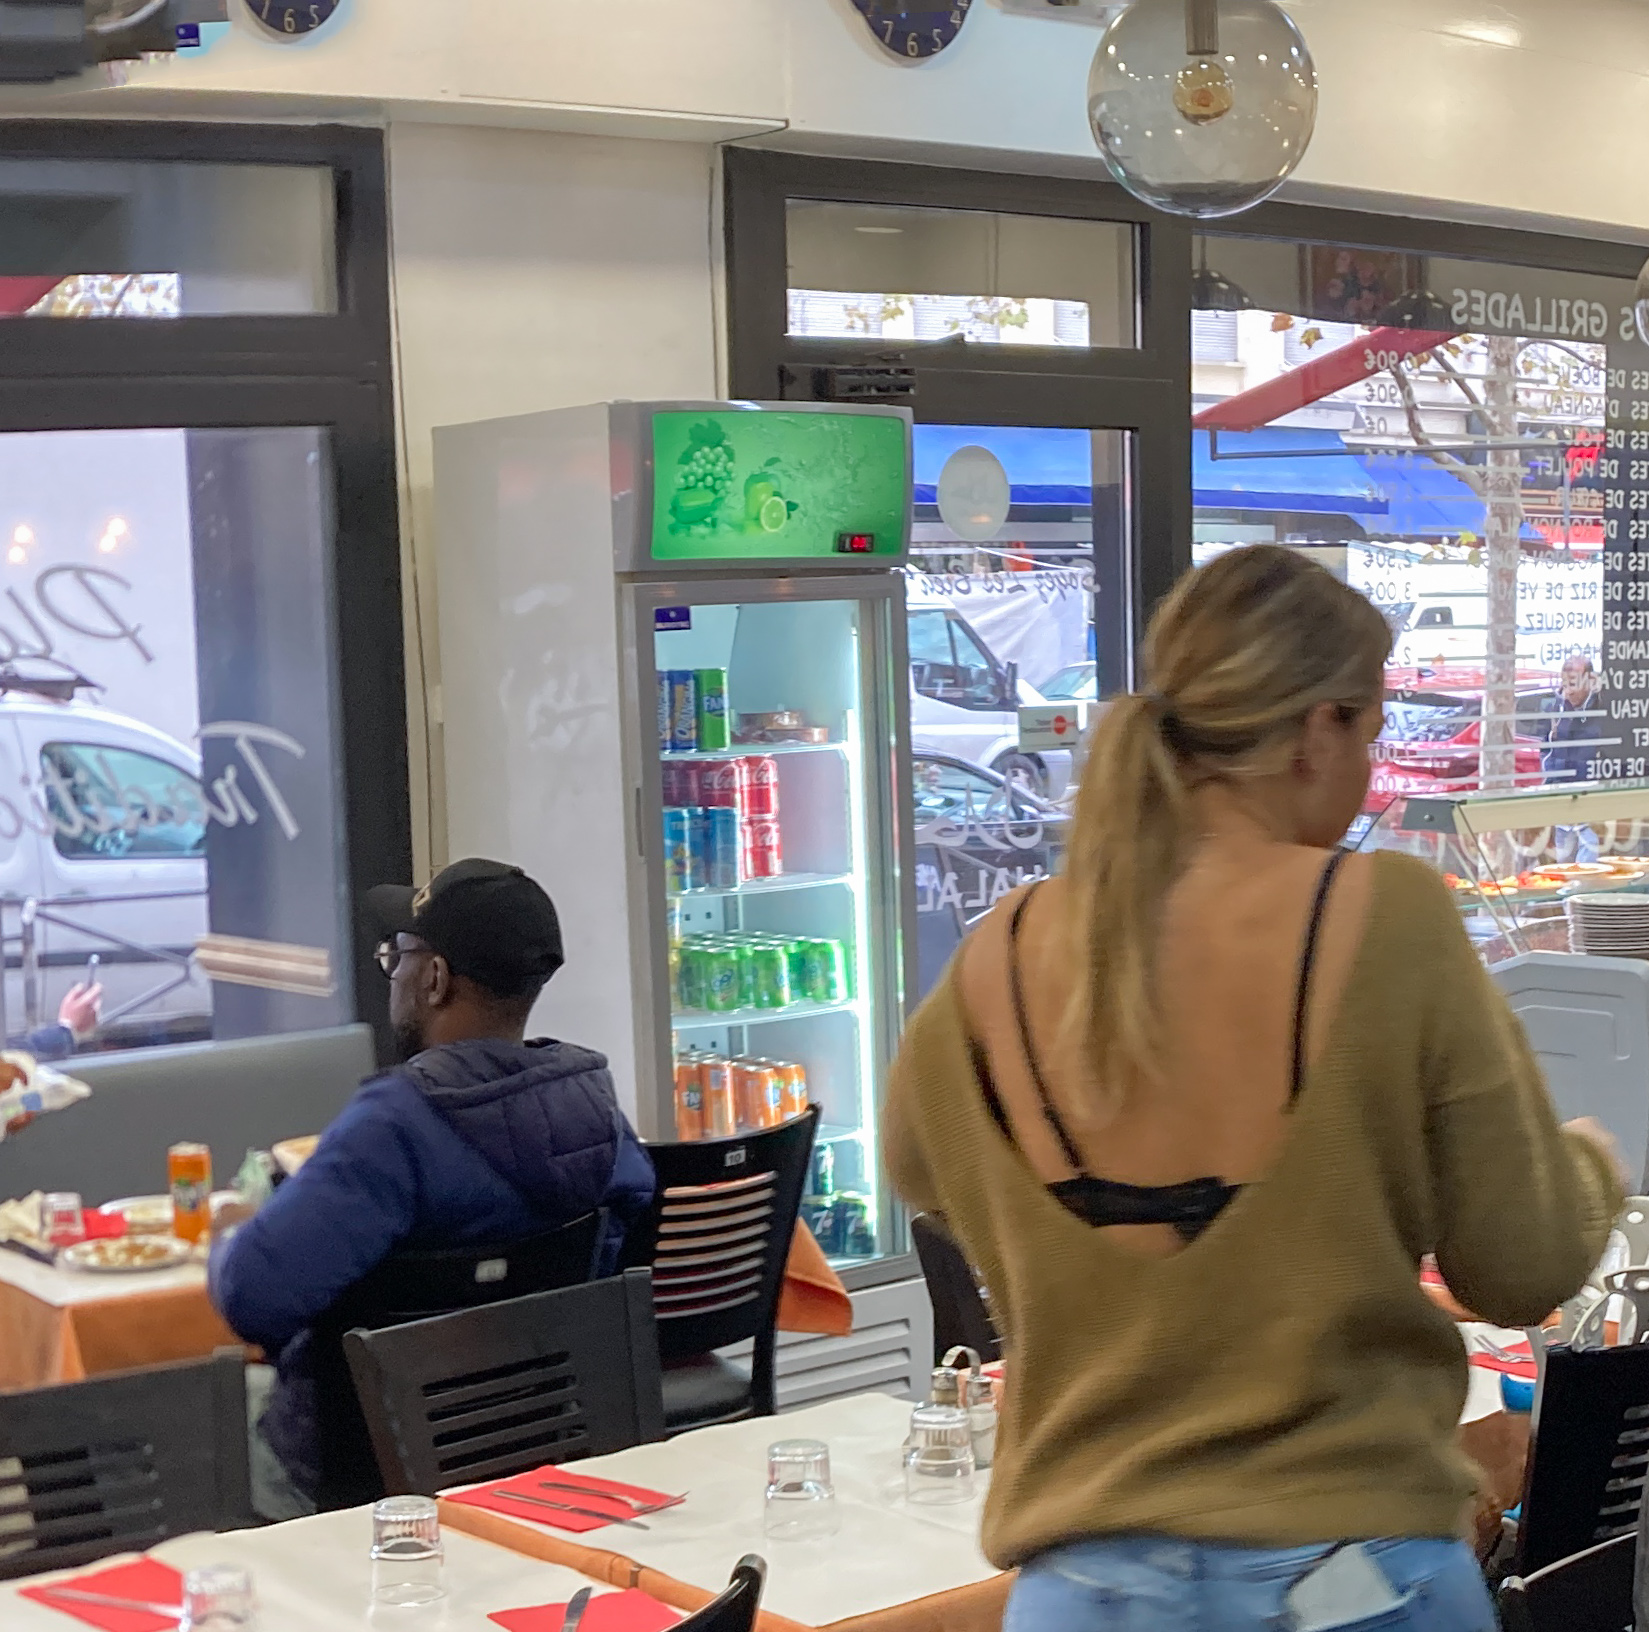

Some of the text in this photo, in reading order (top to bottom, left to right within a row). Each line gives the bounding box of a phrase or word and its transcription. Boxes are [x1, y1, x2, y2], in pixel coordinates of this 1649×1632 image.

[284, 8, 295, 32] 6
[309, 4, 319, 28] 5
[882, 20, 893, 44] 7
[906, 32, 918, 56] 6
[932, 28, 942, 52] 5
[727, 1151, 742, 1165] 10
